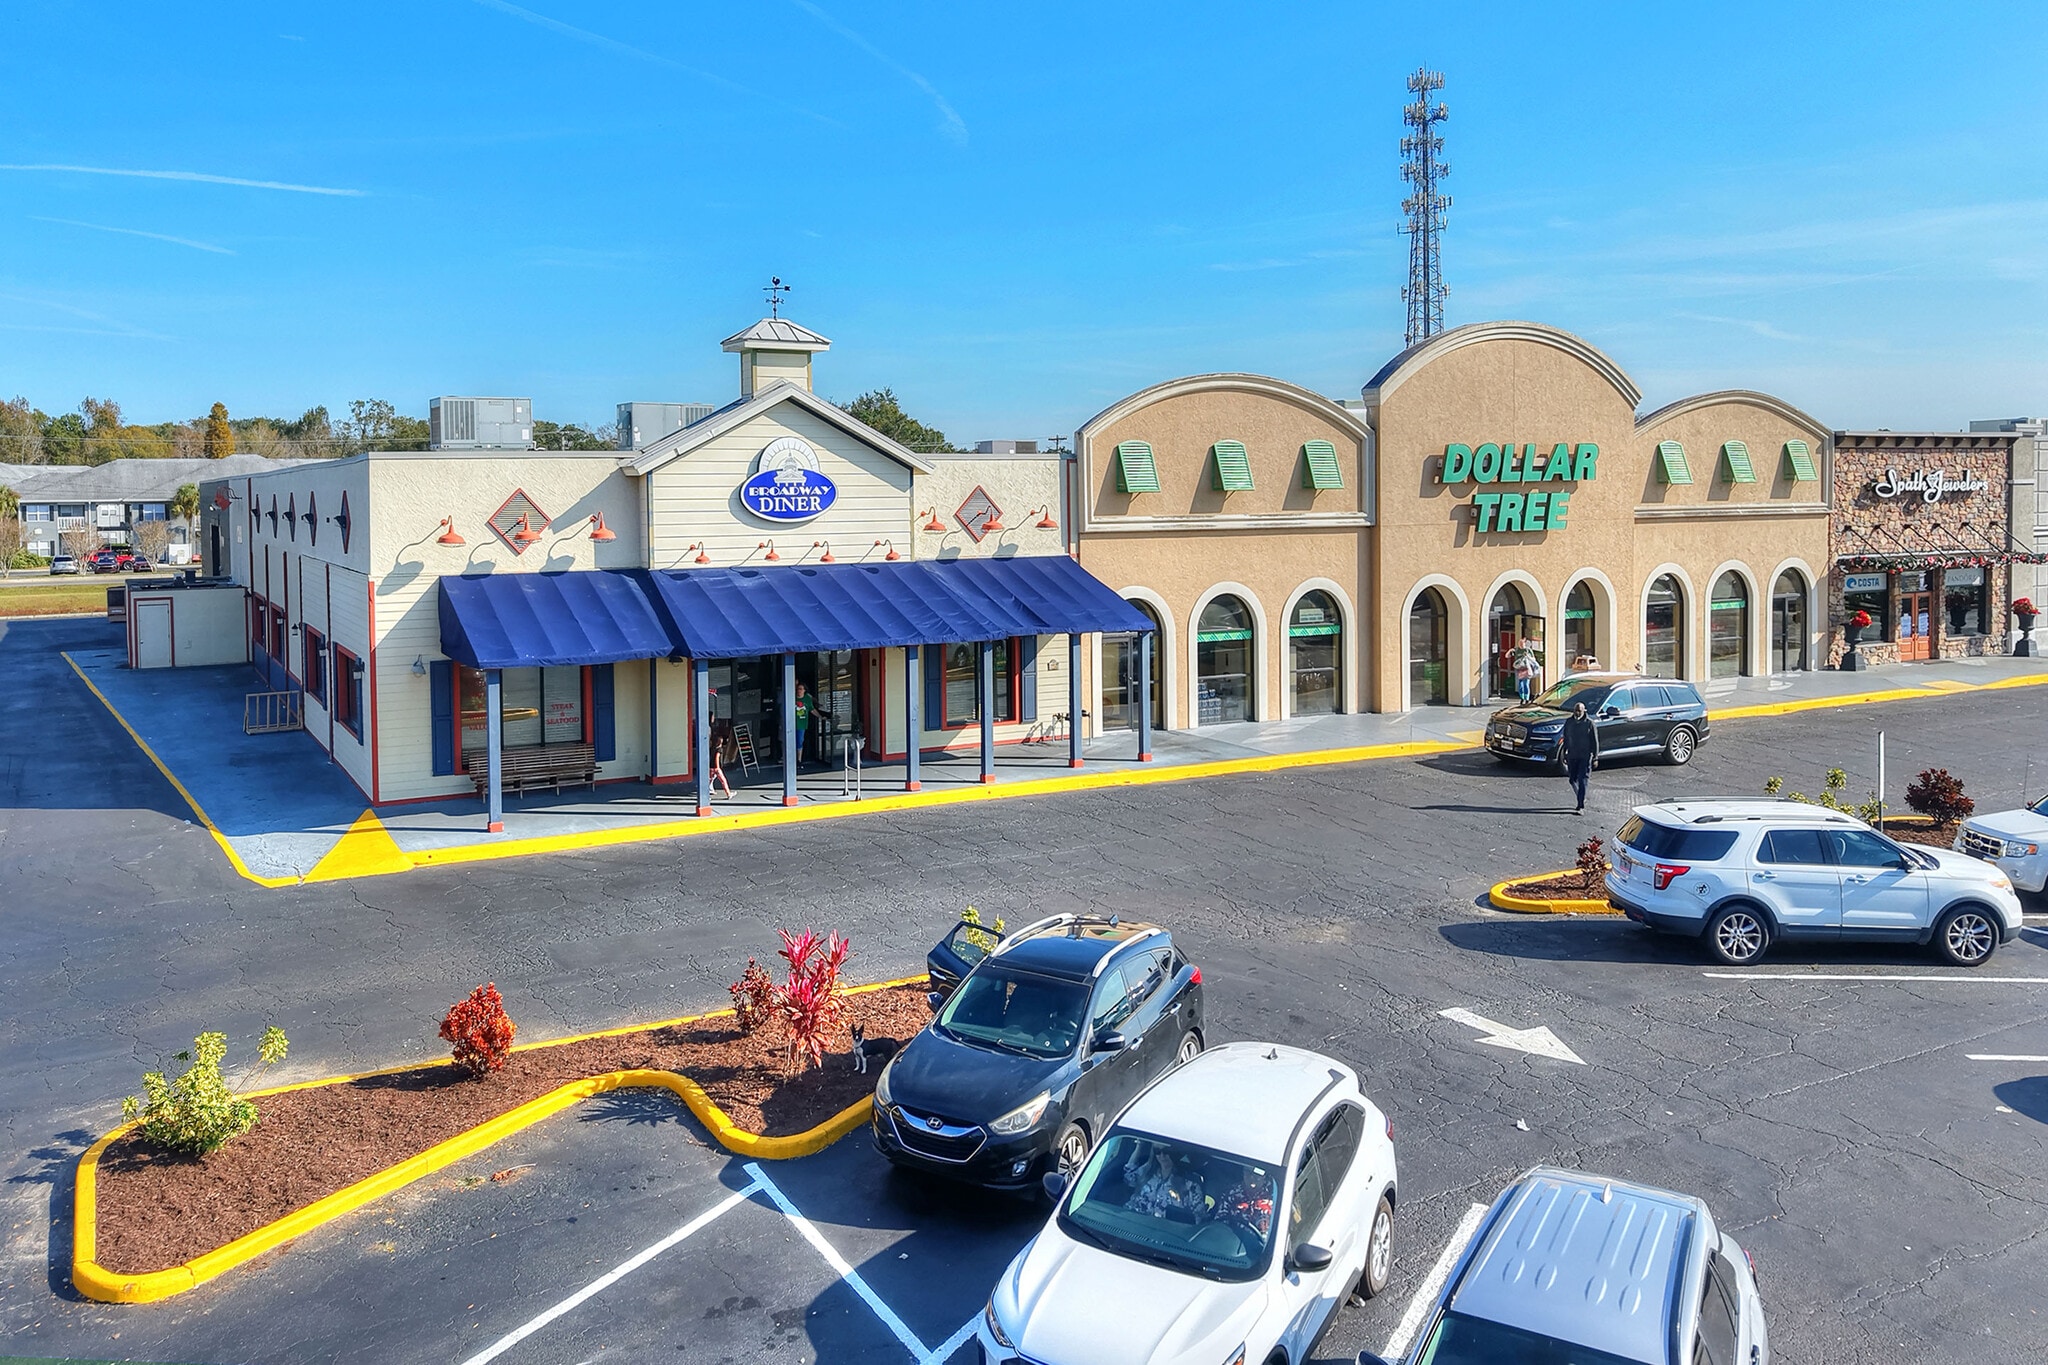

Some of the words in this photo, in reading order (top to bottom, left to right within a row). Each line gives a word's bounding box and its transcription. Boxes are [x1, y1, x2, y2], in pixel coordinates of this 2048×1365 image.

[1442, 442, 1600, 484] DOLLAR
[749, 485, 832, 497] BROADWAY
[1875, 469, 1928, 498] Spath
[1923, 469, 1989, 503] Jewelers
[758, 496, 823, 512] DINER
[1474, 491, 1571, 533] TREE
[1857, 577, 1880, 587] COSTA
[546, 717, 579, 725] SEAFOOD
